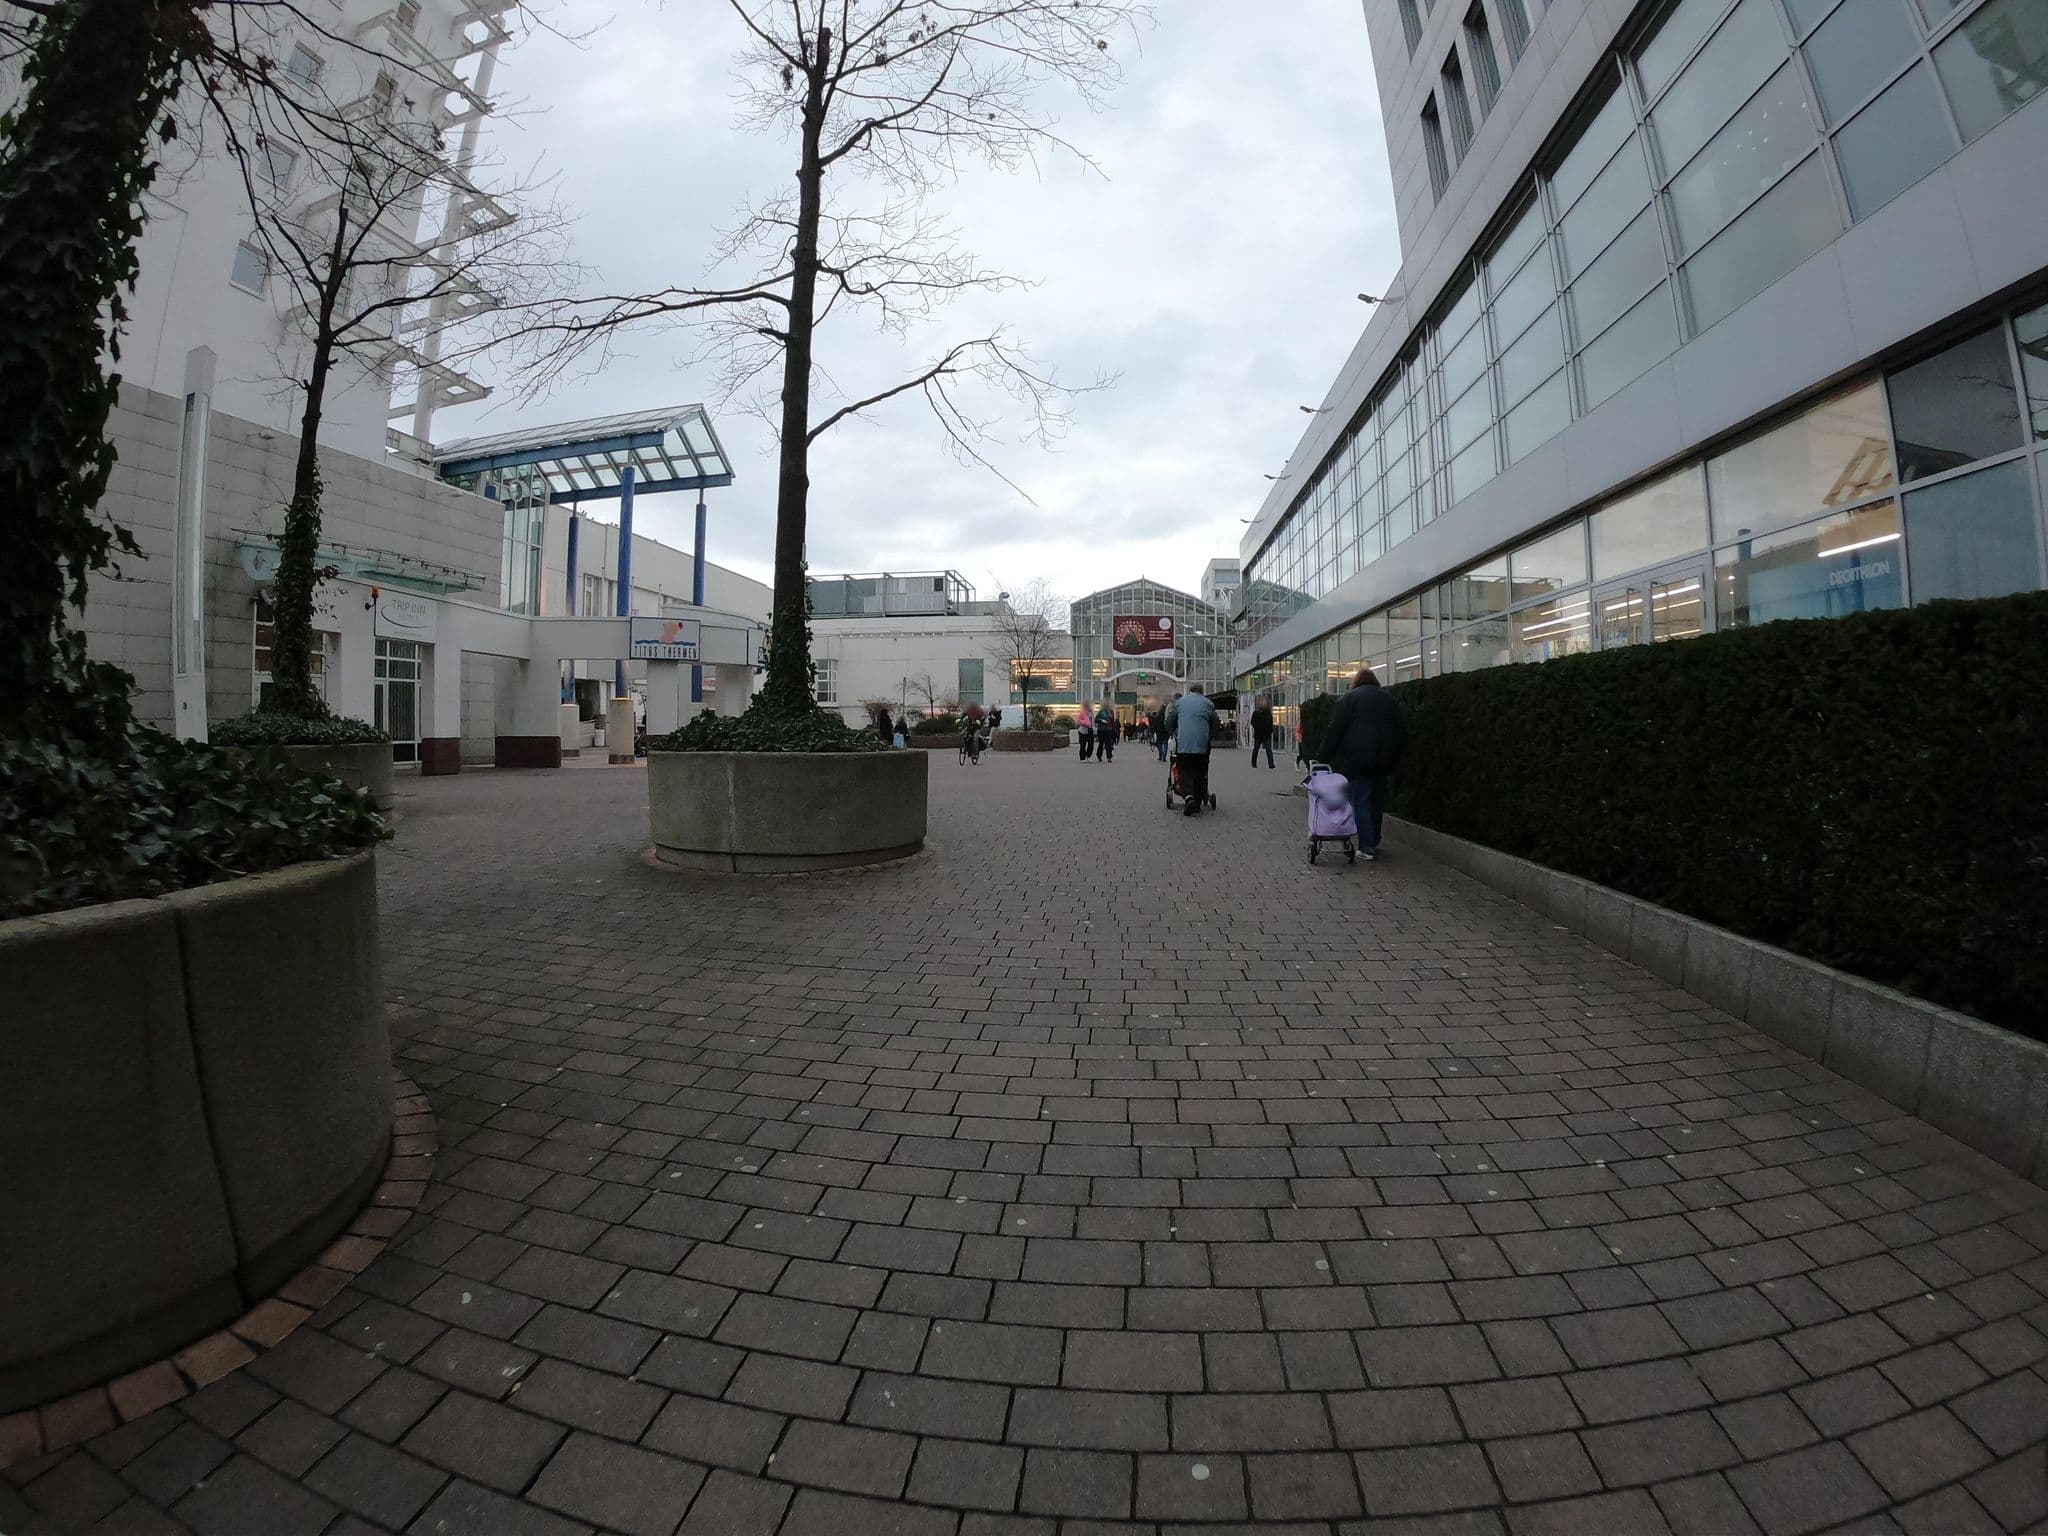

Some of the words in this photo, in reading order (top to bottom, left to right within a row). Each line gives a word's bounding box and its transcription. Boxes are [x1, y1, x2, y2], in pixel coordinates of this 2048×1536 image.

[391, 599, 411, 611] TRIP
[411, 603, 426, 615] INN
[634, 645, 658, 658] TITUS
